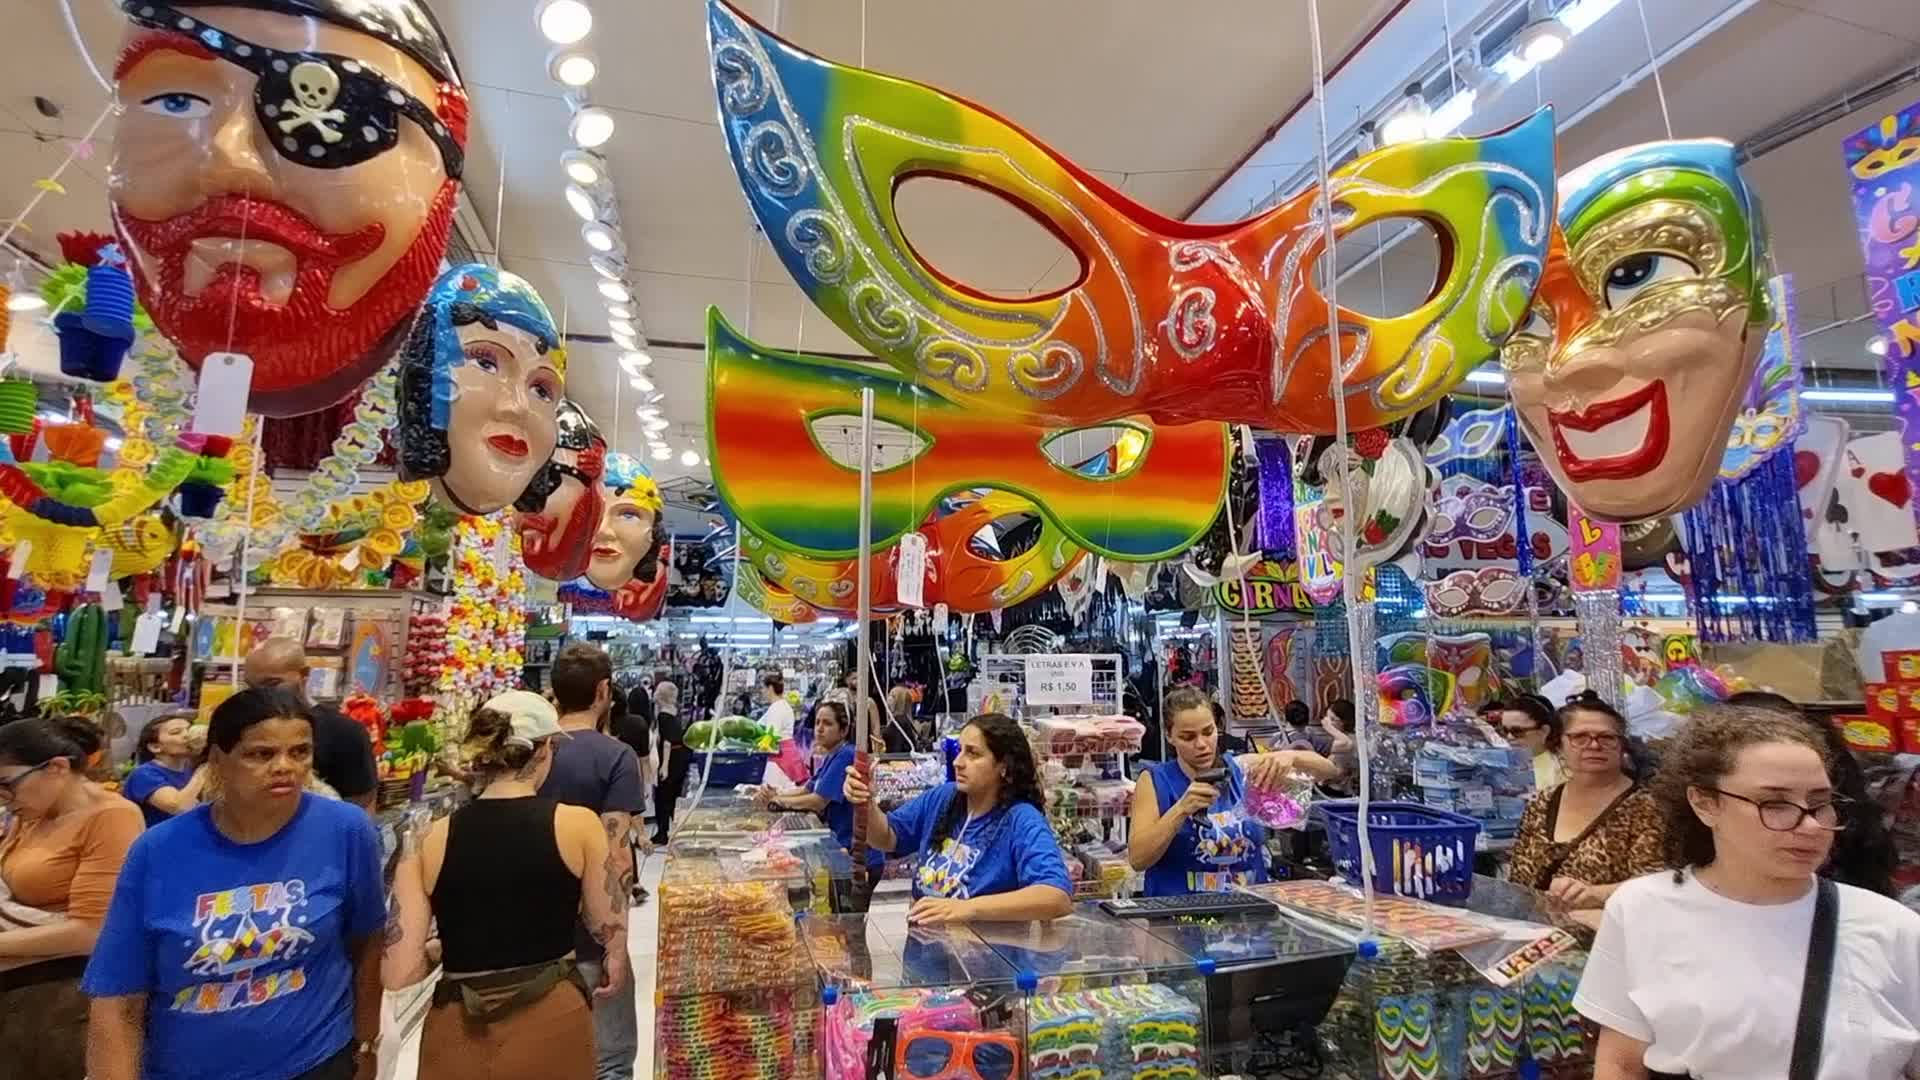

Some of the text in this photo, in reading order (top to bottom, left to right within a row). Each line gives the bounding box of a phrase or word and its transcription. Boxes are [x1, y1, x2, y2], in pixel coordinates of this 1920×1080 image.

[1459, 531, 1552, 560] VEGS
[1031, 660, 1063, 669] LETRAS
[1040, 682, 1077, 693] R$ 1,50
[195, 879, 305, 921] FESTAS
